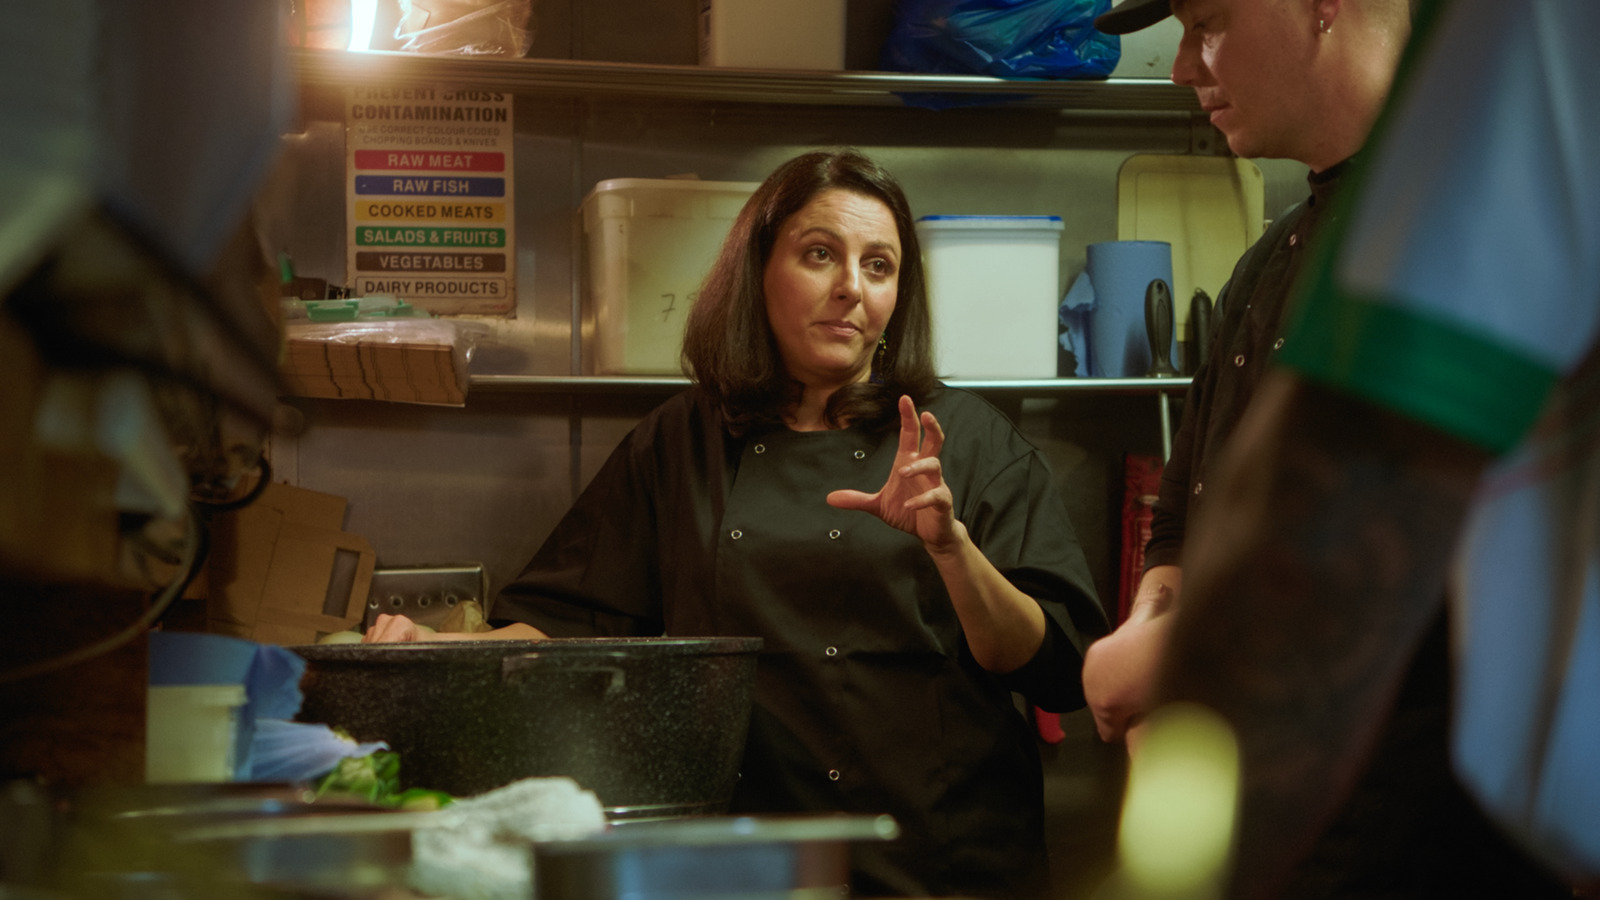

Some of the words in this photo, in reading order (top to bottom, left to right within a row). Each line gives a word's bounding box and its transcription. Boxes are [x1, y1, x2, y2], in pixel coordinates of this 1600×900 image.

[352, 104, 508, 122] CONTAMINATION
[380, 125, 425, 135] CORRECT
[427, 126, 466, 136] COLOUR
[468, 127, 500, 136] CODED
[363, 135, 413, 145] CHOPPING
[415, 136, 455, 146] BOARDS
[456, 137, 461, 146] &
[463, 137, 497, 147] KNIVES
[388, 153, 425, 167] RAW
[429, 154, 473, 168] MEAT
[393, 179, 429, 192] RAW
[433, 180, 469, 193] FISH
[368, 204, 437, 217] COOKED
[441, 206, 494, 219] MEATS
[364, 229, 426, 243] SALADS
[429, 230, 440, 243] &
[443, 231, 499, 244] FRUITS
[379, 255, 484, 270] VEGETABLES
[365, 281, 411, 294] DAIRY
[415, 281, 499, 295] PRODUCTS
